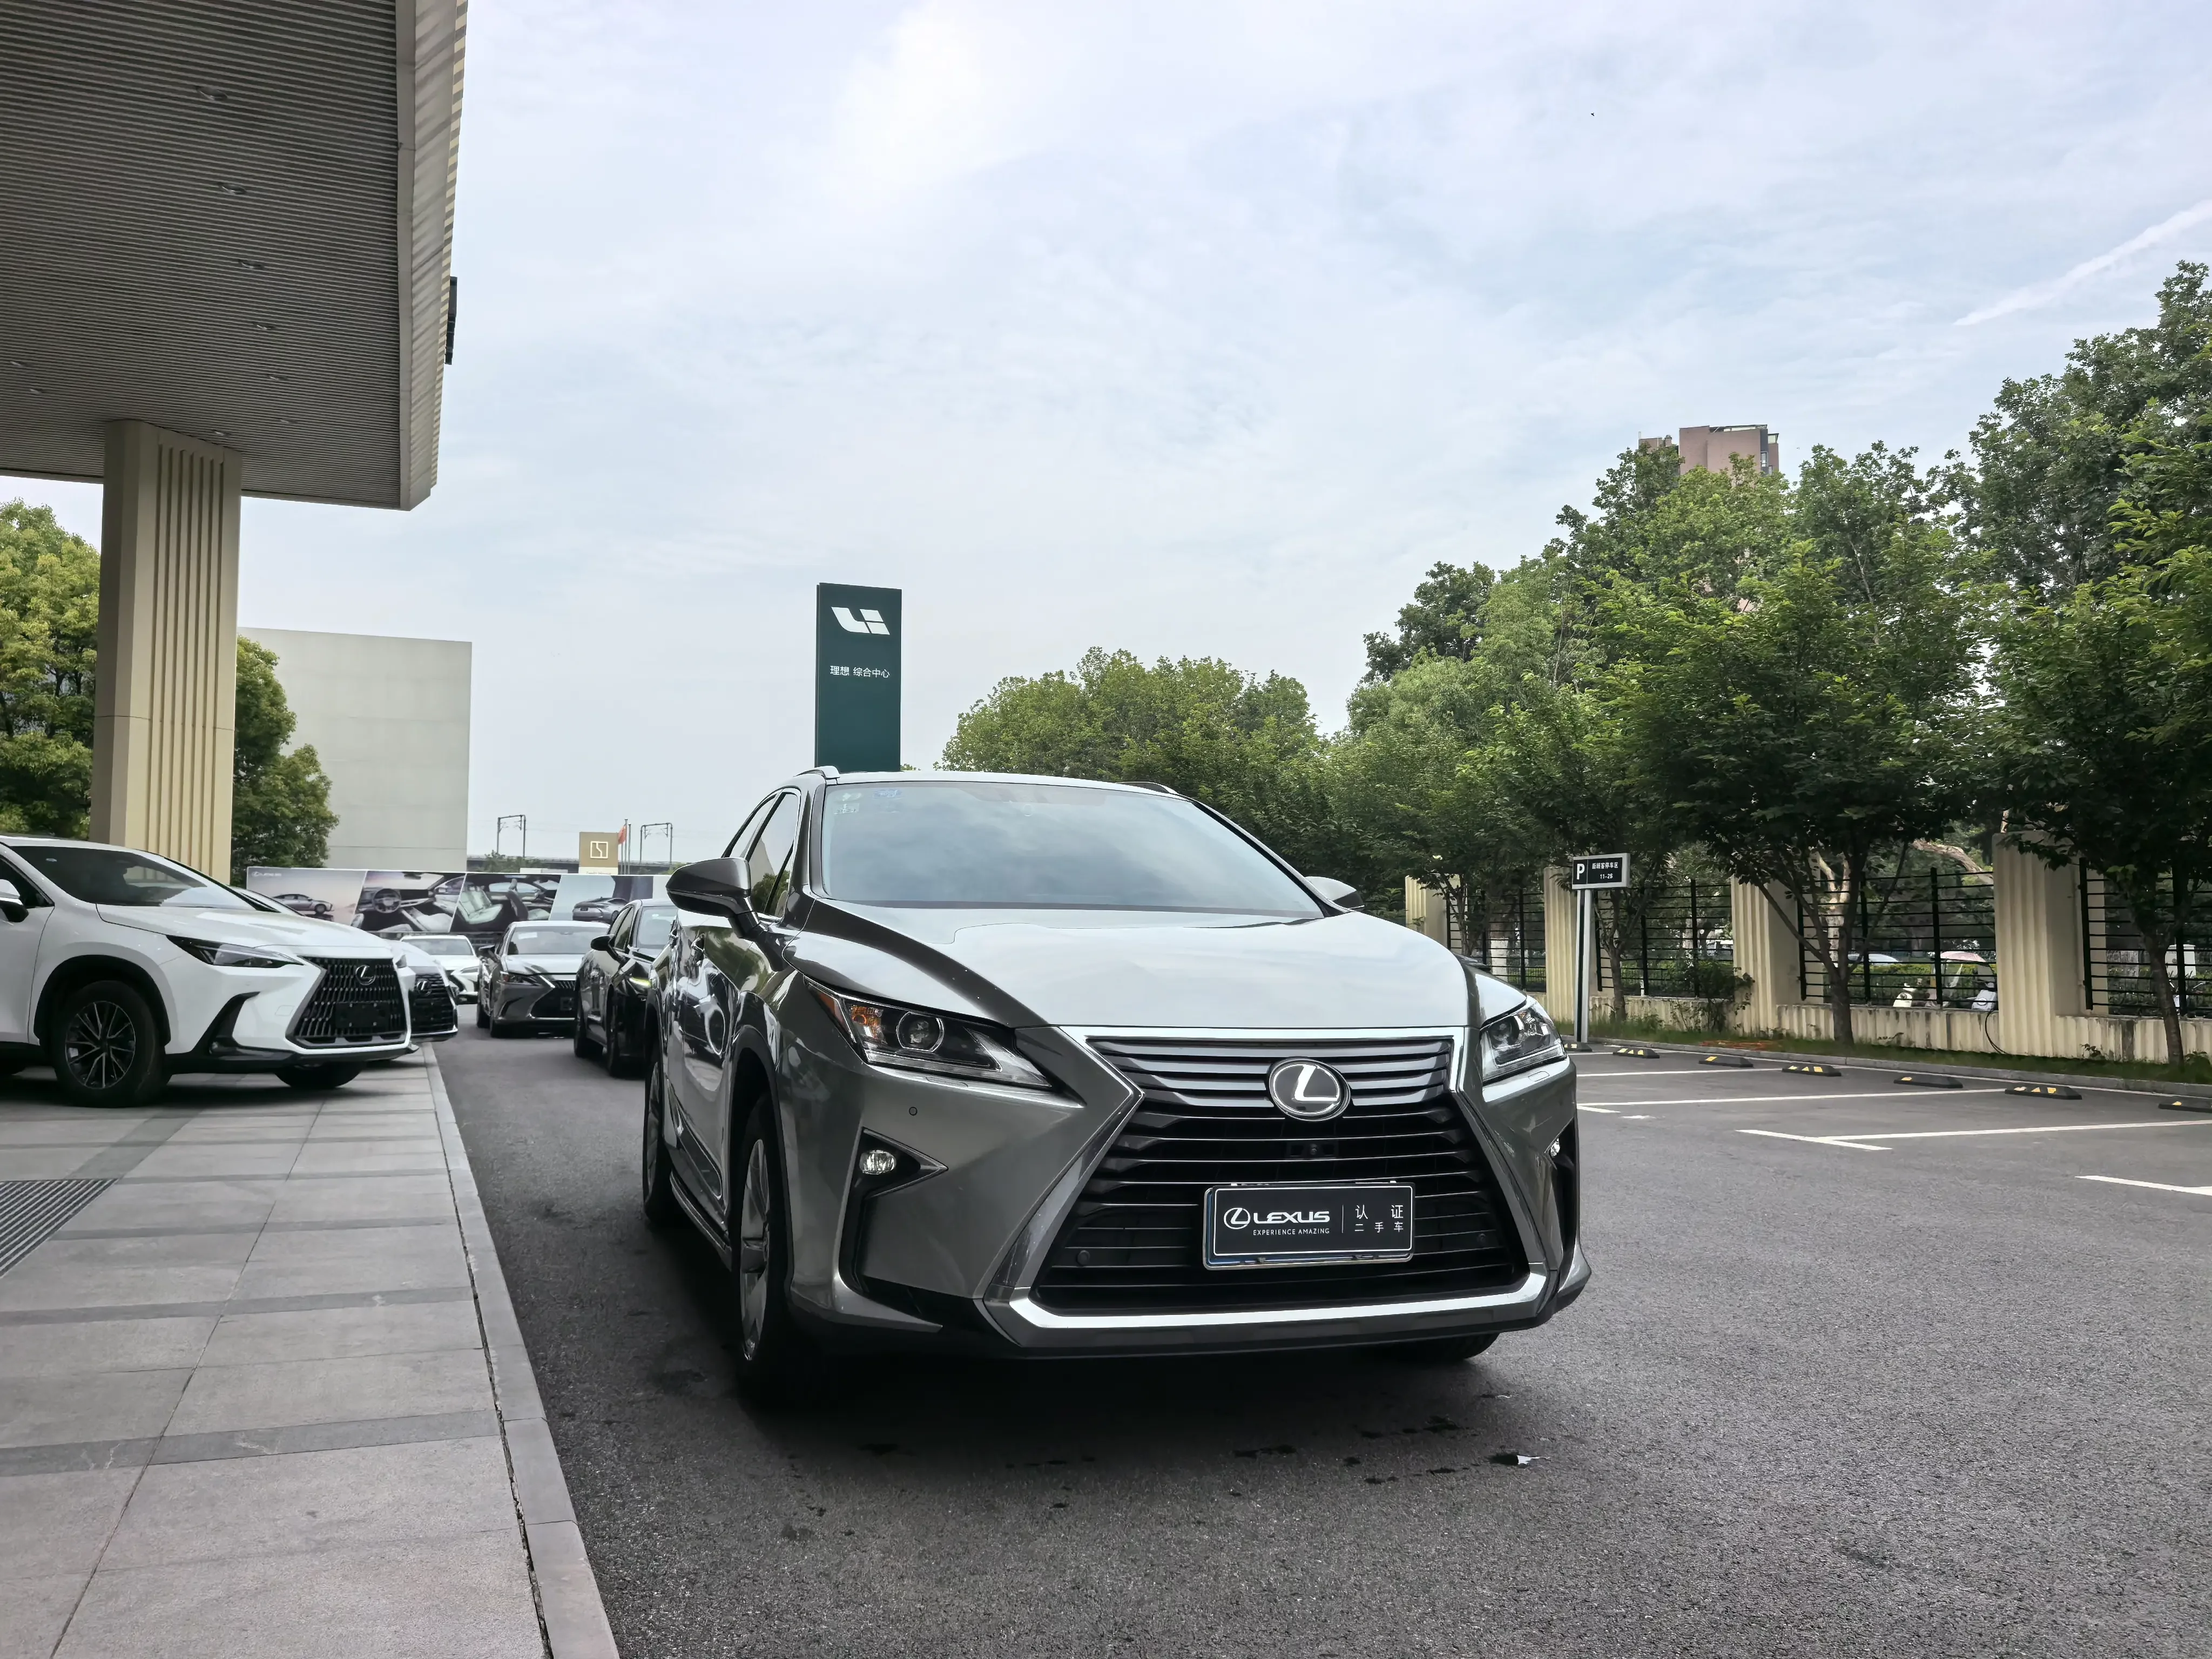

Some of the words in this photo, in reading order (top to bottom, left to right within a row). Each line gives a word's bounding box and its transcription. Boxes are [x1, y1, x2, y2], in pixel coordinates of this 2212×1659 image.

[830, 665, 849, 676] 理想
[853, 667, 890, 678] 综合中心
[1576, 863, 1585, 880] P
[1253, 1210, 1330, 1224] LEXUS
[1355, 1204, 1404, 1220] 认证
[1354, 1221, 1404, 1233] 二手车
